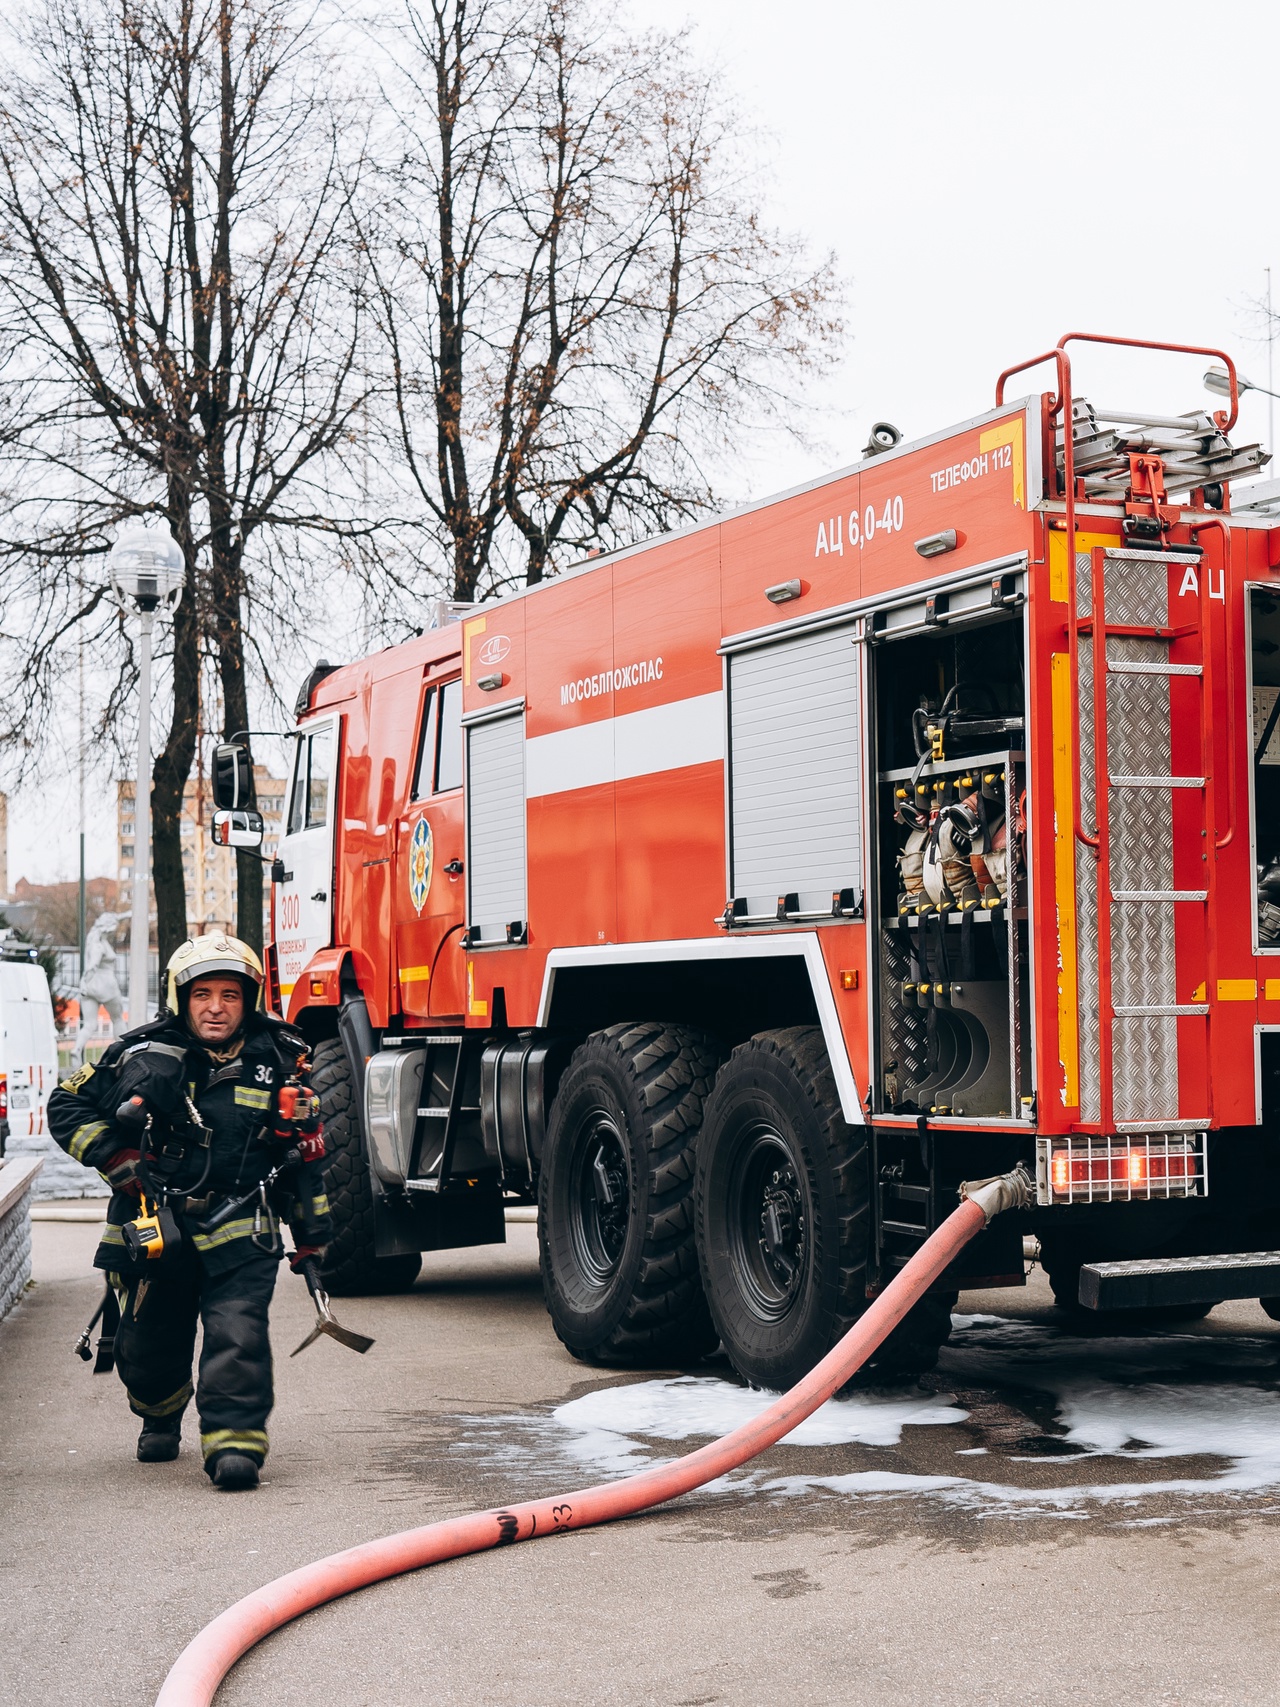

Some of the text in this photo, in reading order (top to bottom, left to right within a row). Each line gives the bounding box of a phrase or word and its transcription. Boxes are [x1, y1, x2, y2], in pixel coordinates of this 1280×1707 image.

[930, 445, 1012, 493] ТЕЛЕФОН 112
[815, 495, 904, 557] АЦ 6,0-40
[1178, 566, 1225, 605] АЦ
[560, 657, 664, 706] МОСОБЛПОЖСПАС
[281, 894, 300, 930] 300
